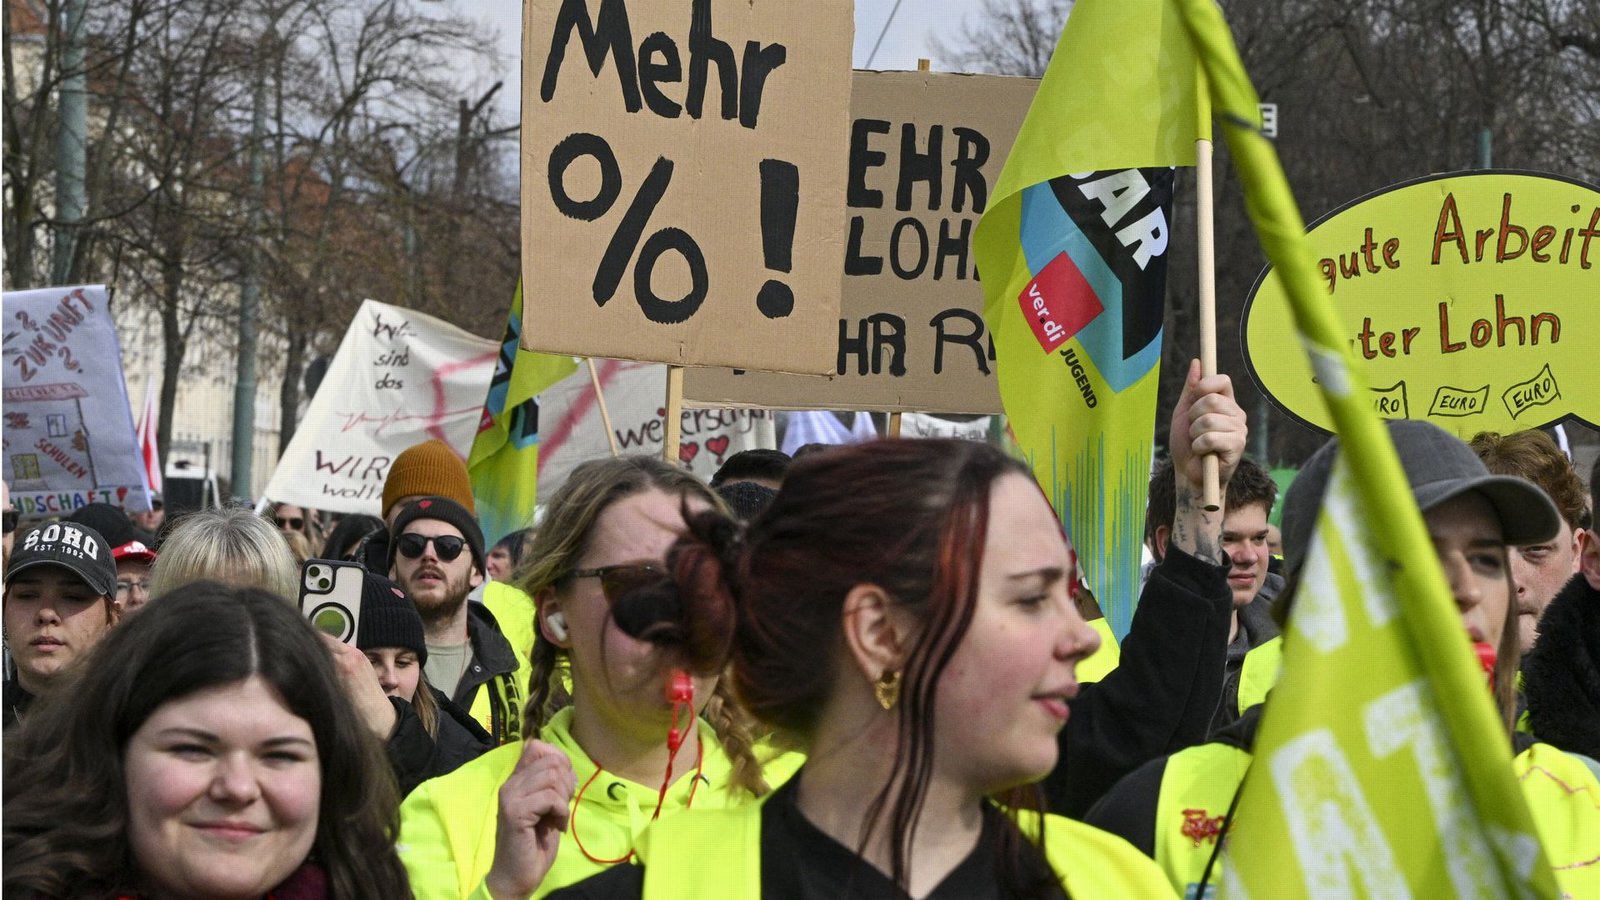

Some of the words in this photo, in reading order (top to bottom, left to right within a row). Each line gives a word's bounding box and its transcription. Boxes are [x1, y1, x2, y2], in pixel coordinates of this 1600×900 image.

[540, 0, 787, 129] Mehr
[846, 118, 990, 215] EHR
[844, 215, 981, 282] LOH
[1069, 168, 1169, 271] AR
[1320, 227, 1400, 295] gute
[1430, 192, 1600, 271] Arbeit
[837, 312, 906, 377] HR
[929, 308, 997, 377] R
[1028, 284, 1067, 343] ver.di
[1351, 317, 1421, 360] ter
[1438, 293, 1562, 354] Lohn
[373, 345, 409, 367] sind
[1060, 347, 1099, 410] JUGEND
[1439, 397, 1477, 411] EURO
[1512, 377, 1551, 410] EURO
[34, 438, 88, 480] SCHULEN
[315, 450, 390, 481] WIR
[24, 524, 99, 560] SOHO
[34, 544, 56, 552] EST.
